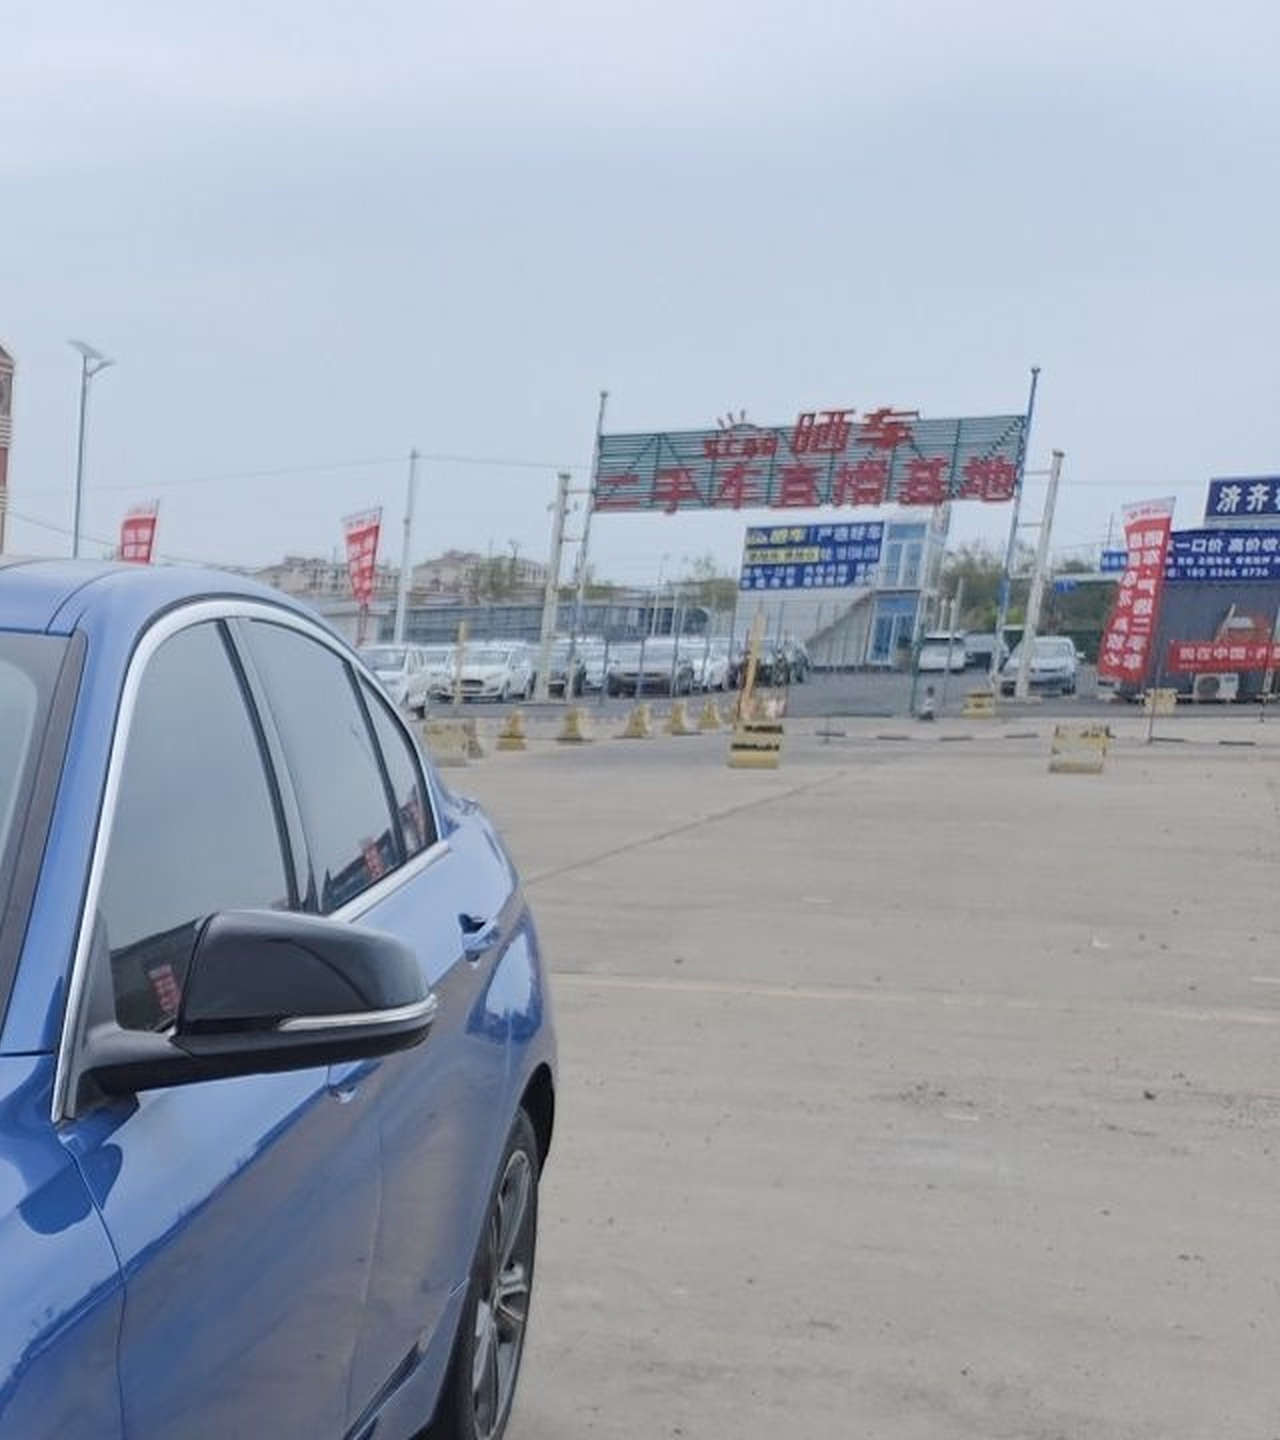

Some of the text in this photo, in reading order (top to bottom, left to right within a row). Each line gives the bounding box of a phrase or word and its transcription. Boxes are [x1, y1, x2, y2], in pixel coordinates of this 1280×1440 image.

[595, 454, 1018, 514] 二手车直播基地
[1215, 483, 1280, 513] 济齐
